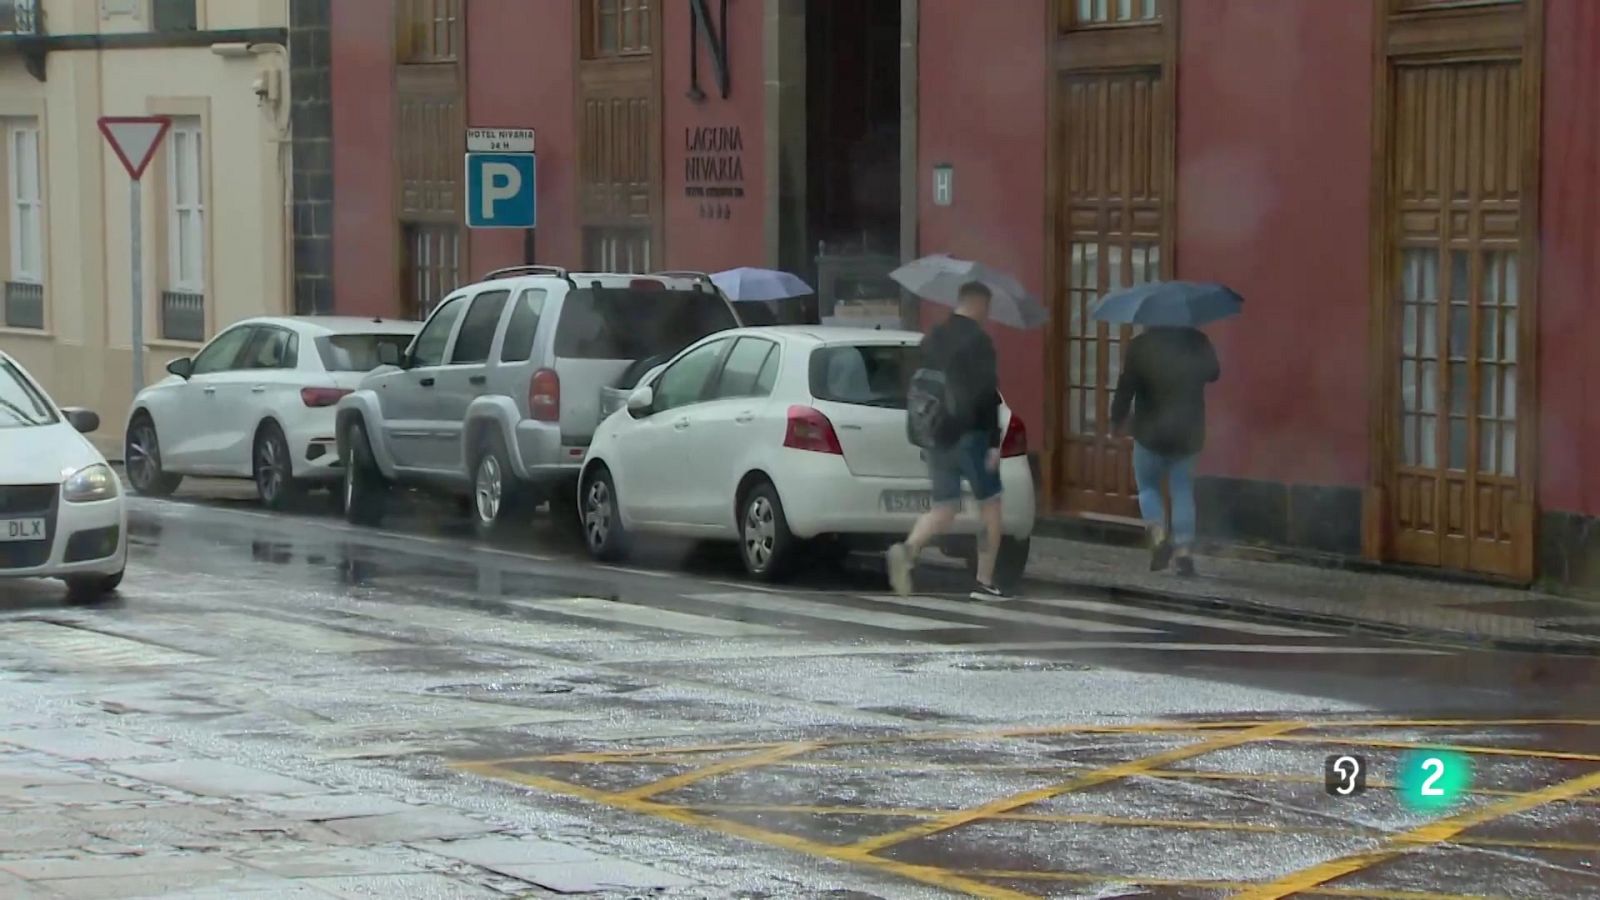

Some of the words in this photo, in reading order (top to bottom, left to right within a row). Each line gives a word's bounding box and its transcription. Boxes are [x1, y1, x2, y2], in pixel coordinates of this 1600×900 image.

[468, 130, 496, 139] HOTEL
[499, 130, 533, 139] NIVARIA
[685, 126, 743, 151] LAGUNA
[685, 156, 744, 181] NIVARIA
[482, 162, 522, 219] P
[937, 172, 948, 201] H
[9, 520, 41, 537] DLX
